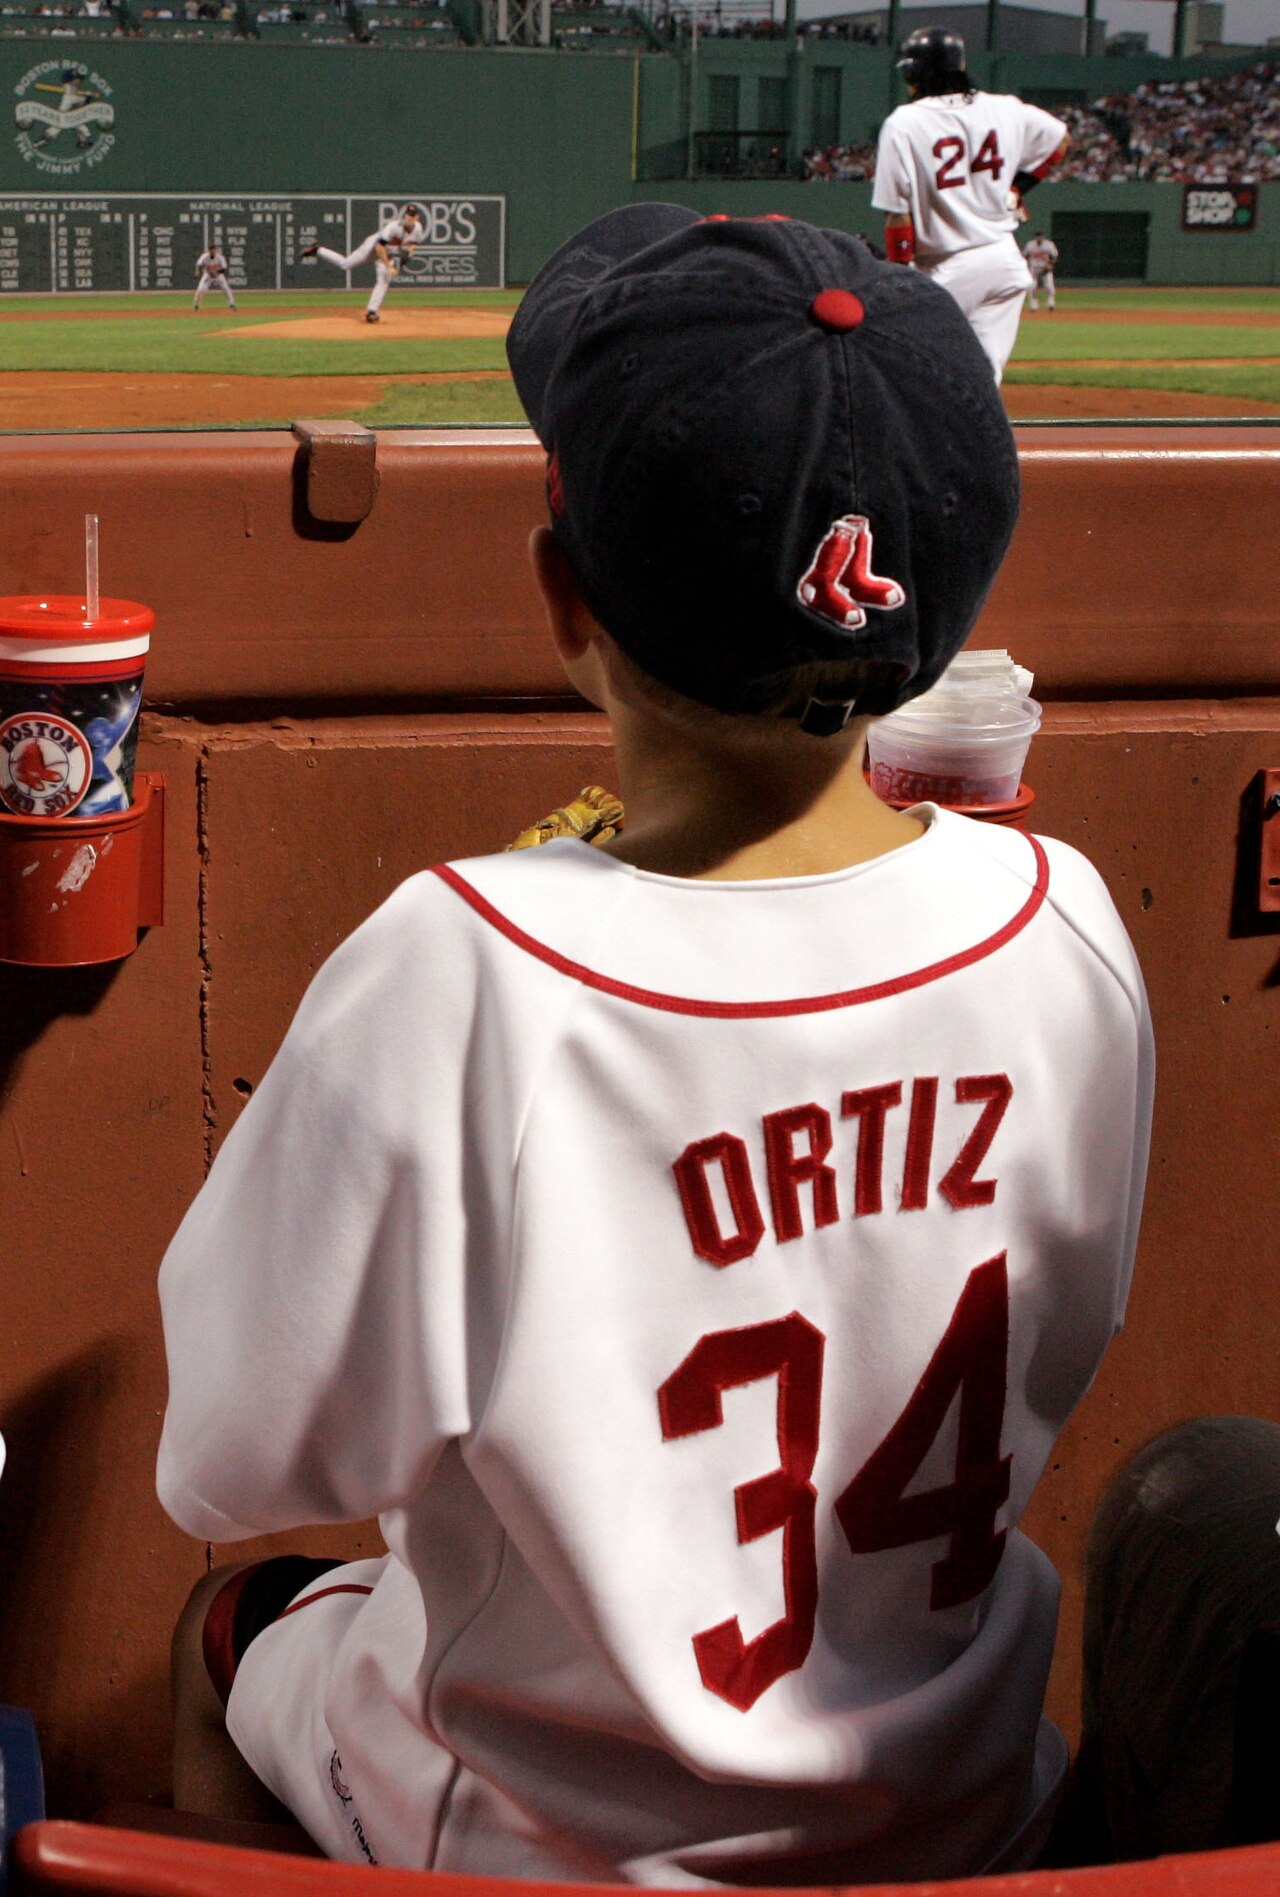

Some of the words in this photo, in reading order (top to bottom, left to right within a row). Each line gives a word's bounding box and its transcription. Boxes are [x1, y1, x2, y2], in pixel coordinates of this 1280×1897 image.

[14, 60, 60, 96] BOSTON
[36, 161, 81, 175] JIMMY
[86, 134, 116, 168] FUND
[932, 129, 1005, 190] 24
[63, 201, 109, 210] LEAGUE
[190, 202, 245, 211] NATIONAL
[249, 202, 293, 210] LEAGUE
[1186, 208, 1234, 224] SHOP
[393, 256, 475, 274] TORES
[0, 721, 79, 753] BOSTON
[3, 784, 35, 813] RED
[45, 786, 79, 813] SOX
[673, 1073, 1013, 1268] ORTIZ
[657, 1249, 1013, 1714] 34
